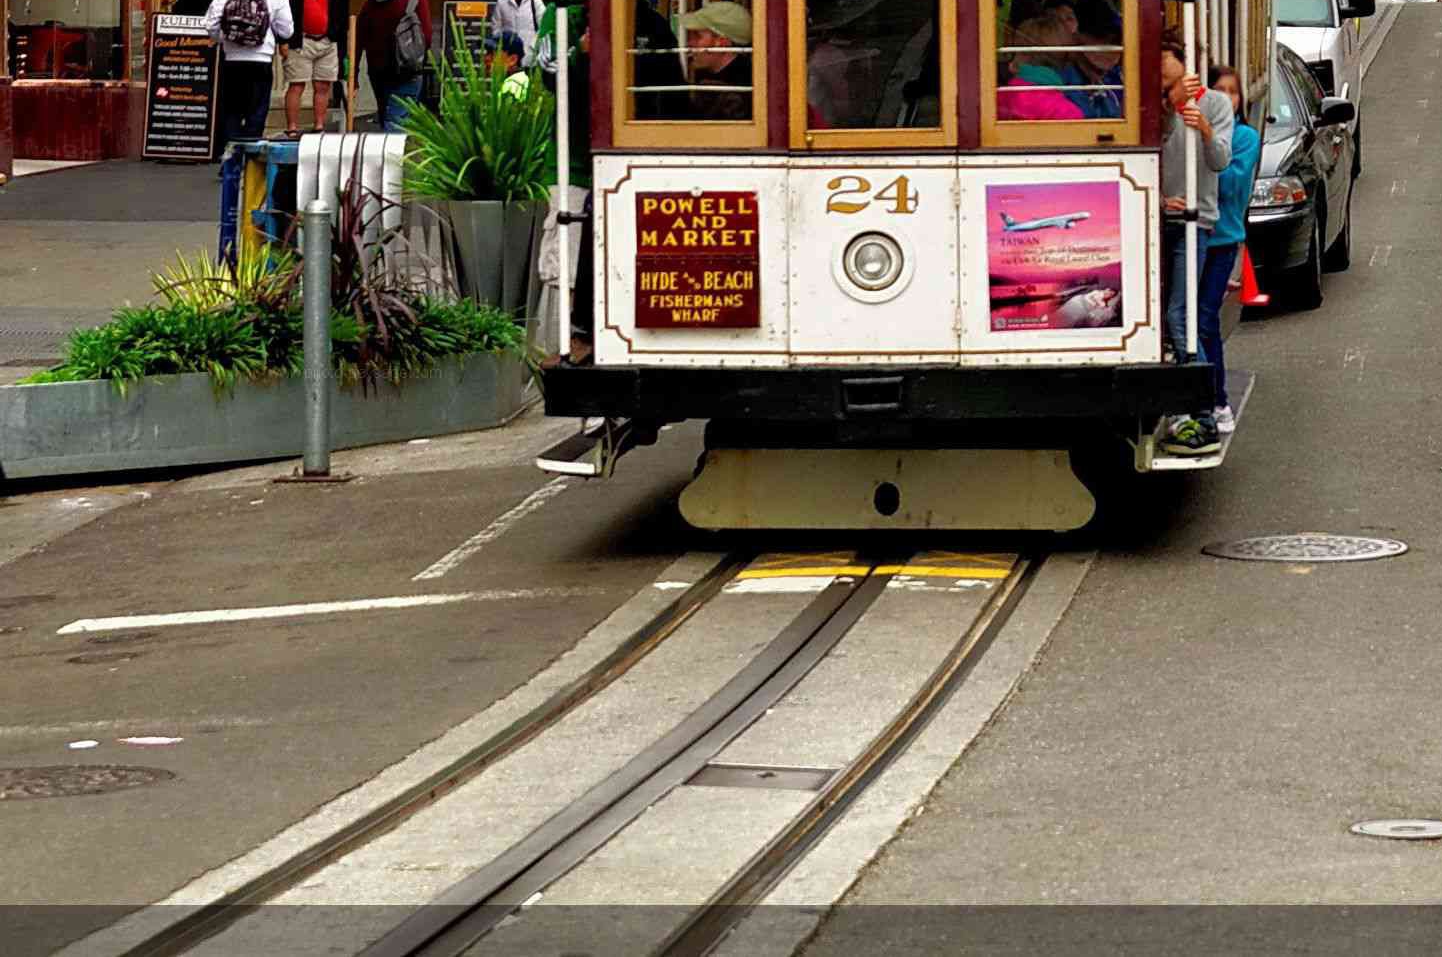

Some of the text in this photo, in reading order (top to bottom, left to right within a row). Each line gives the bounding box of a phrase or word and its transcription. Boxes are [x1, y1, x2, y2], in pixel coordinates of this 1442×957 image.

[825, 174, 919, 214] 24
[643, 199, 753, 215] POWELL
[672, 216, 727, 229] AND
[641, 230, 755, 246] MARKET
[640, 271, 678, 290] HYDE
[703, 271, 753, 291] BEACH
[650, 294, 744, 308] FISHERMANS
[672, 309, 720, 322] WHARF
